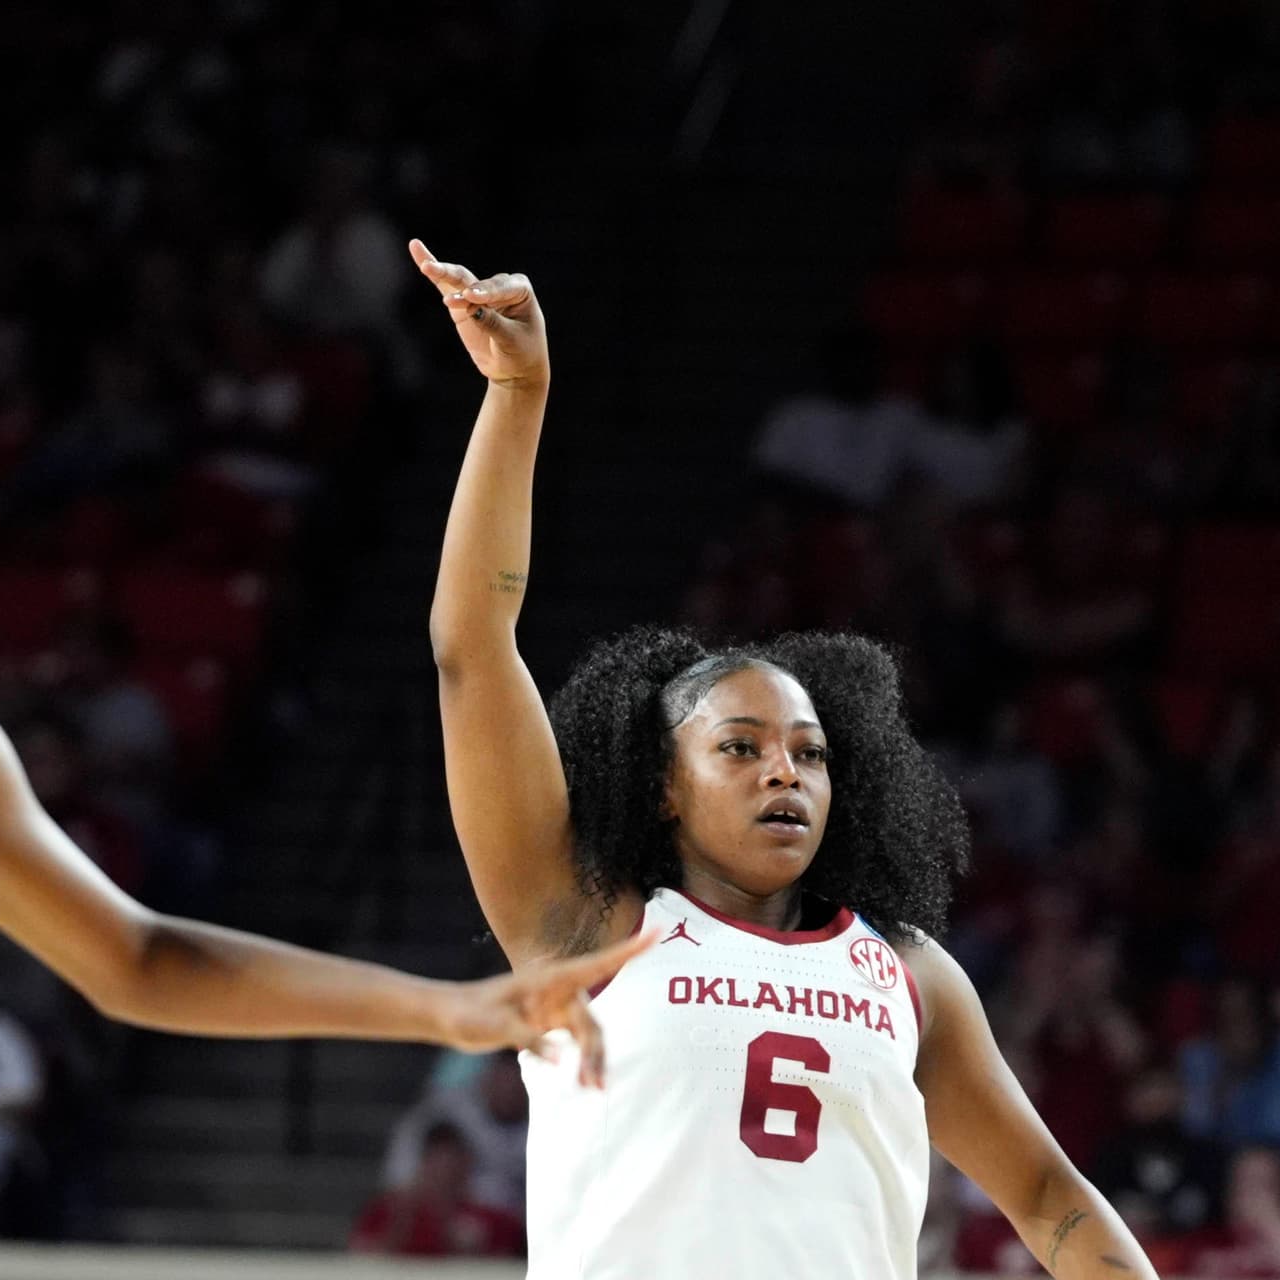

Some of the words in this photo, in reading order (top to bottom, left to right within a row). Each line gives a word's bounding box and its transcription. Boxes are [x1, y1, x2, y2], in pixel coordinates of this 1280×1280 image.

[850, 938, 897, 989] SEC
[667, 976, 897, 1041] OKLAHOMA
[740, 1030, 831, 1163] 6
